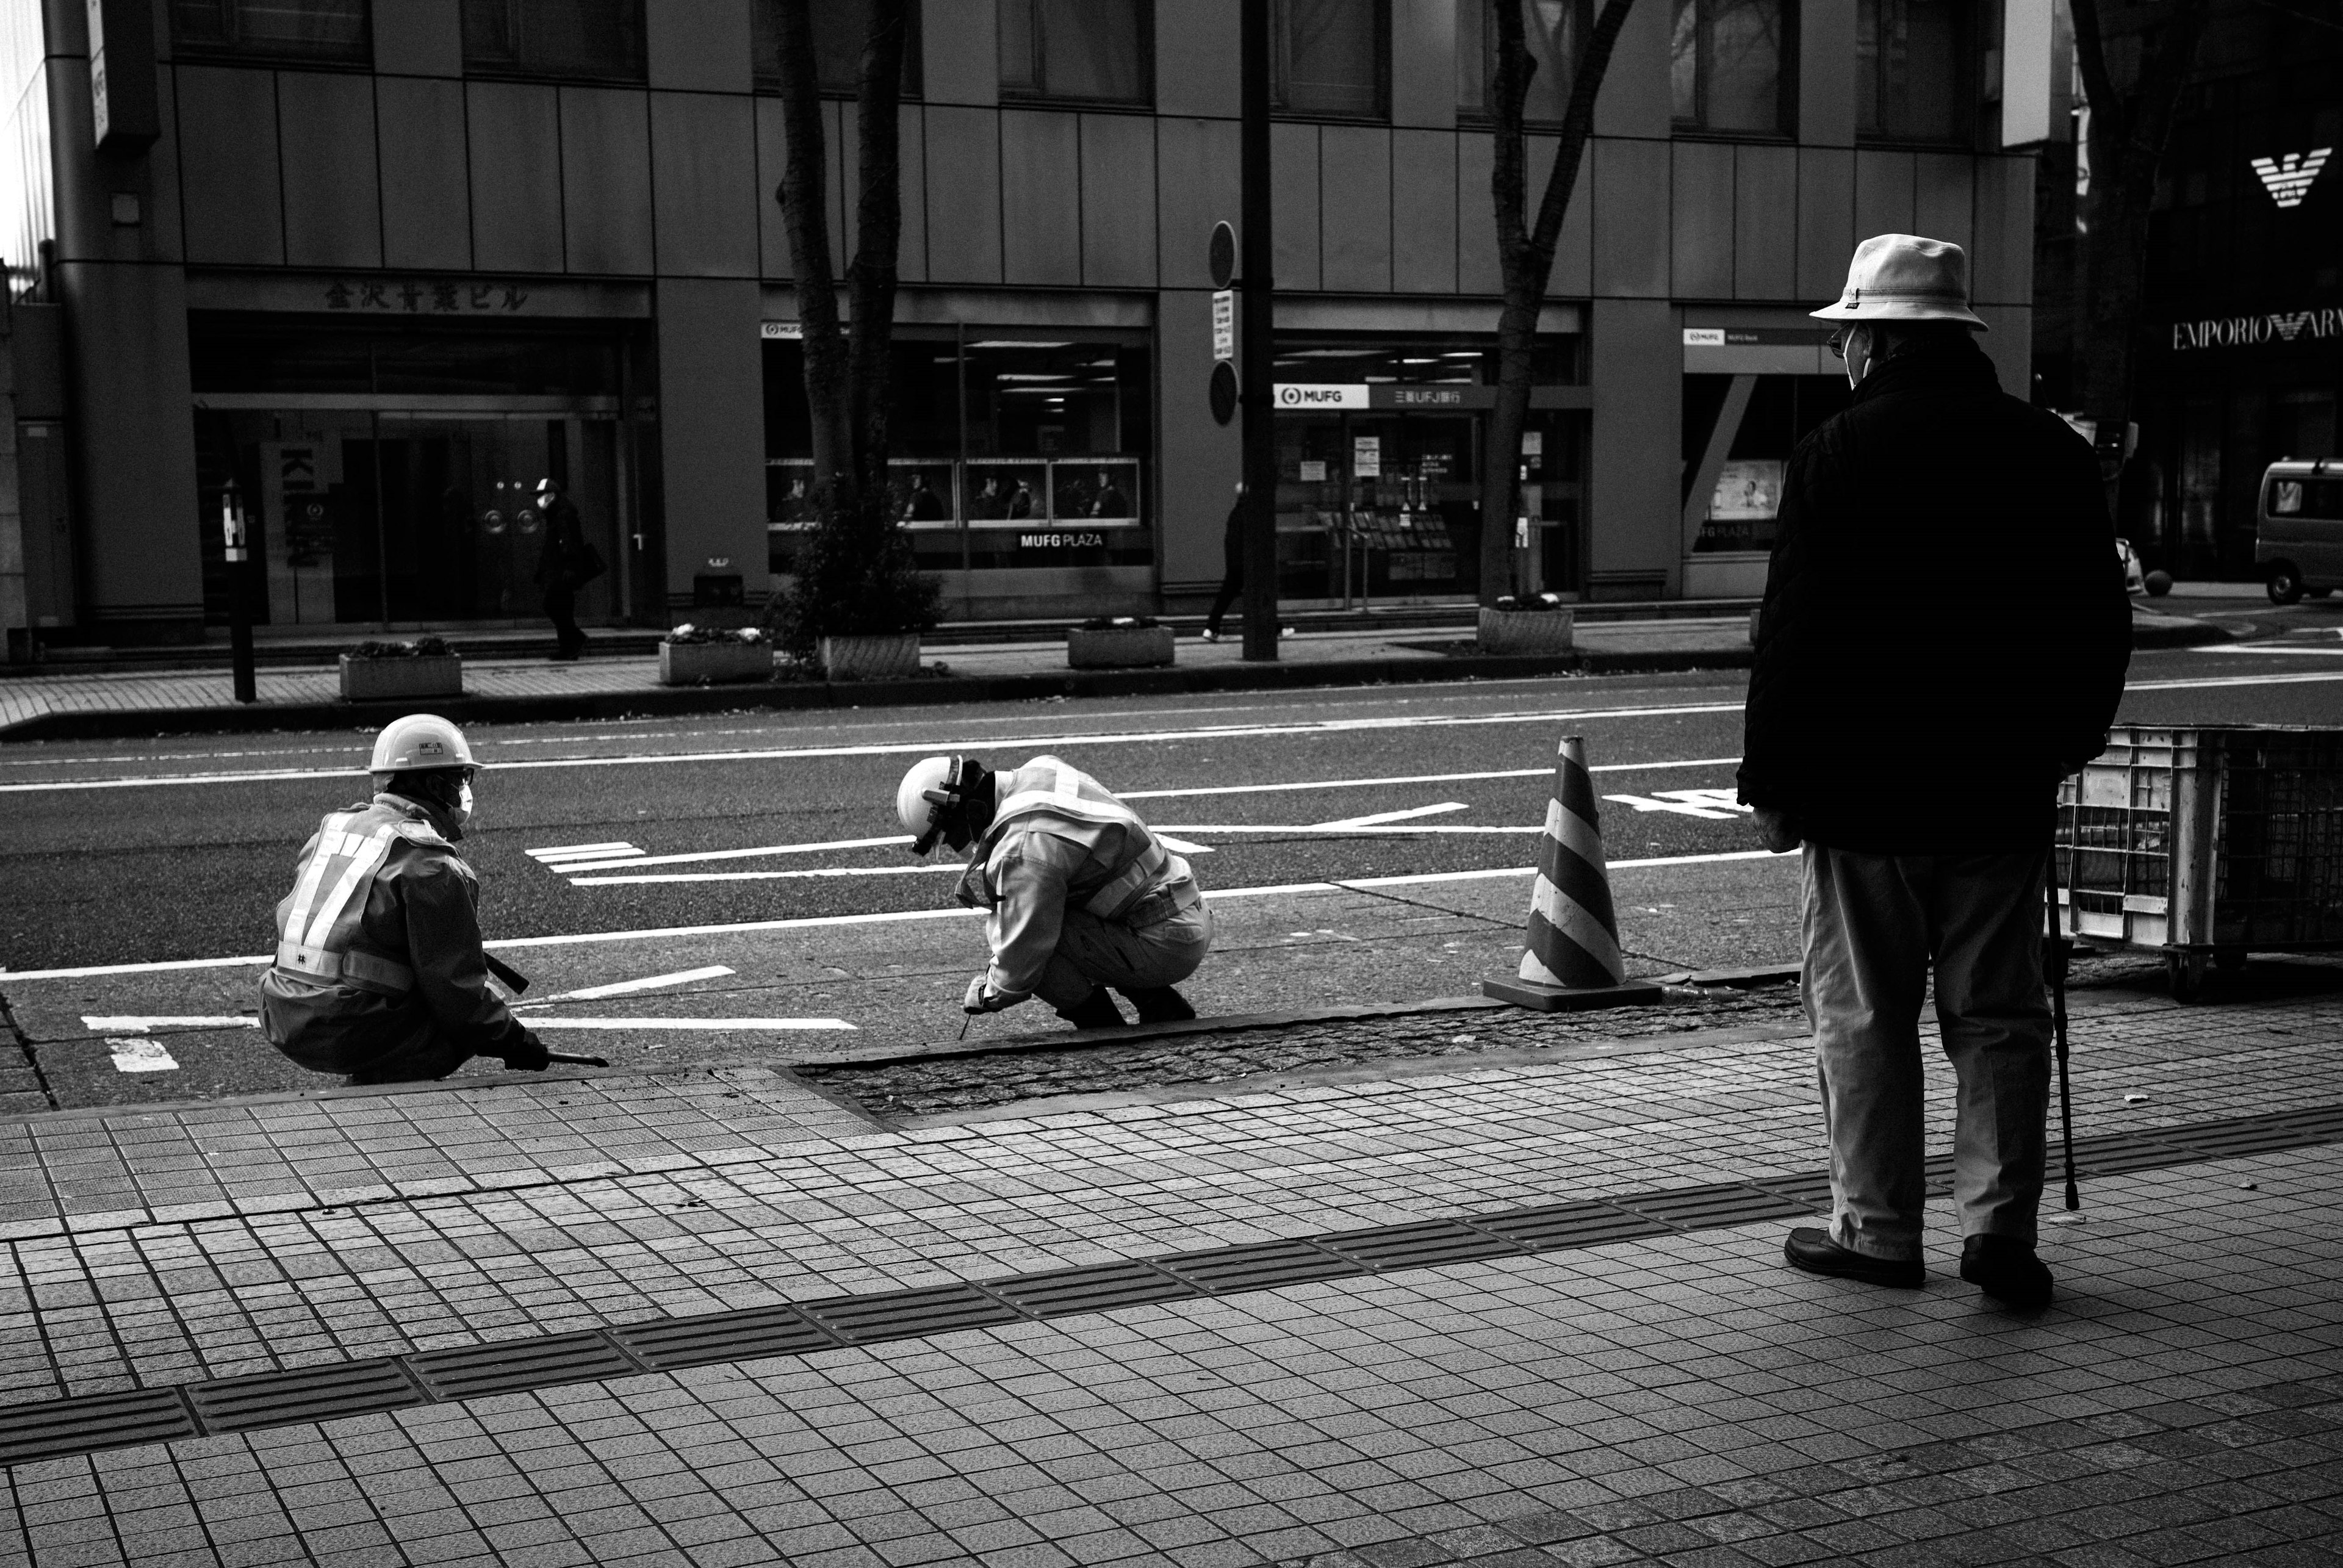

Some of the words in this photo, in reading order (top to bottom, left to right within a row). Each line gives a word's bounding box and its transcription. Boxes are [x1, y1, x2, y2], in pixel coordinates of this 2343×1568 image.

[2173, 315, 2272, 350] EMPORIO
[1305, 390, 1342, 403] MUFG
[1395, 390, 1460, 403] 三菱UFJ銀行
[1021, 534, 1060, 547] MUFG
[1063, 533, 1103, 547] PLAZA
